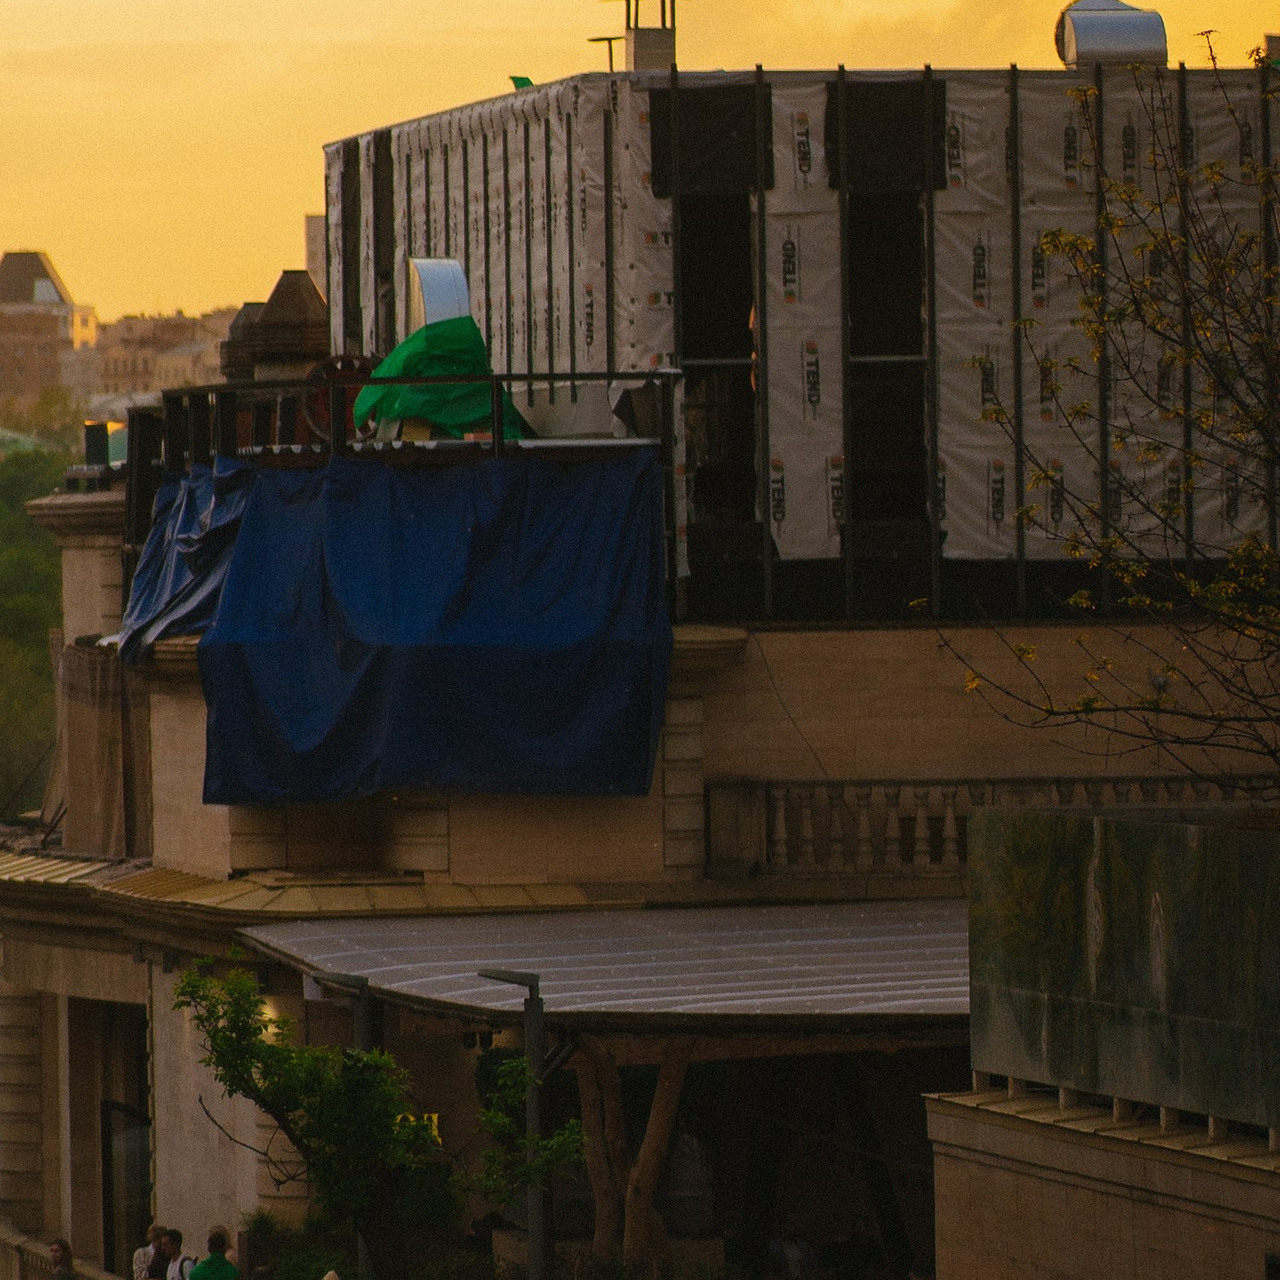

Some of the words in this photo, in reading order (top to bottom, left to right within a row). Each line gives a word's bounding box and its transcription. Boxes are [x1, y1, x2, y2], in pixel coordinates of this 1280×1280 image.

[796, 128, 812, 174] TEND
[782, 240, 796, 287] TEND
[973, 245, 986, 291] TEND
[585, 299, 594, 346] TEND
[806, 356, 821, 404] TEND
[771, 475, 786, 522] TEND
[831, 474, 844, 520] TEND
[992, 476, 1004, 521] TEND
